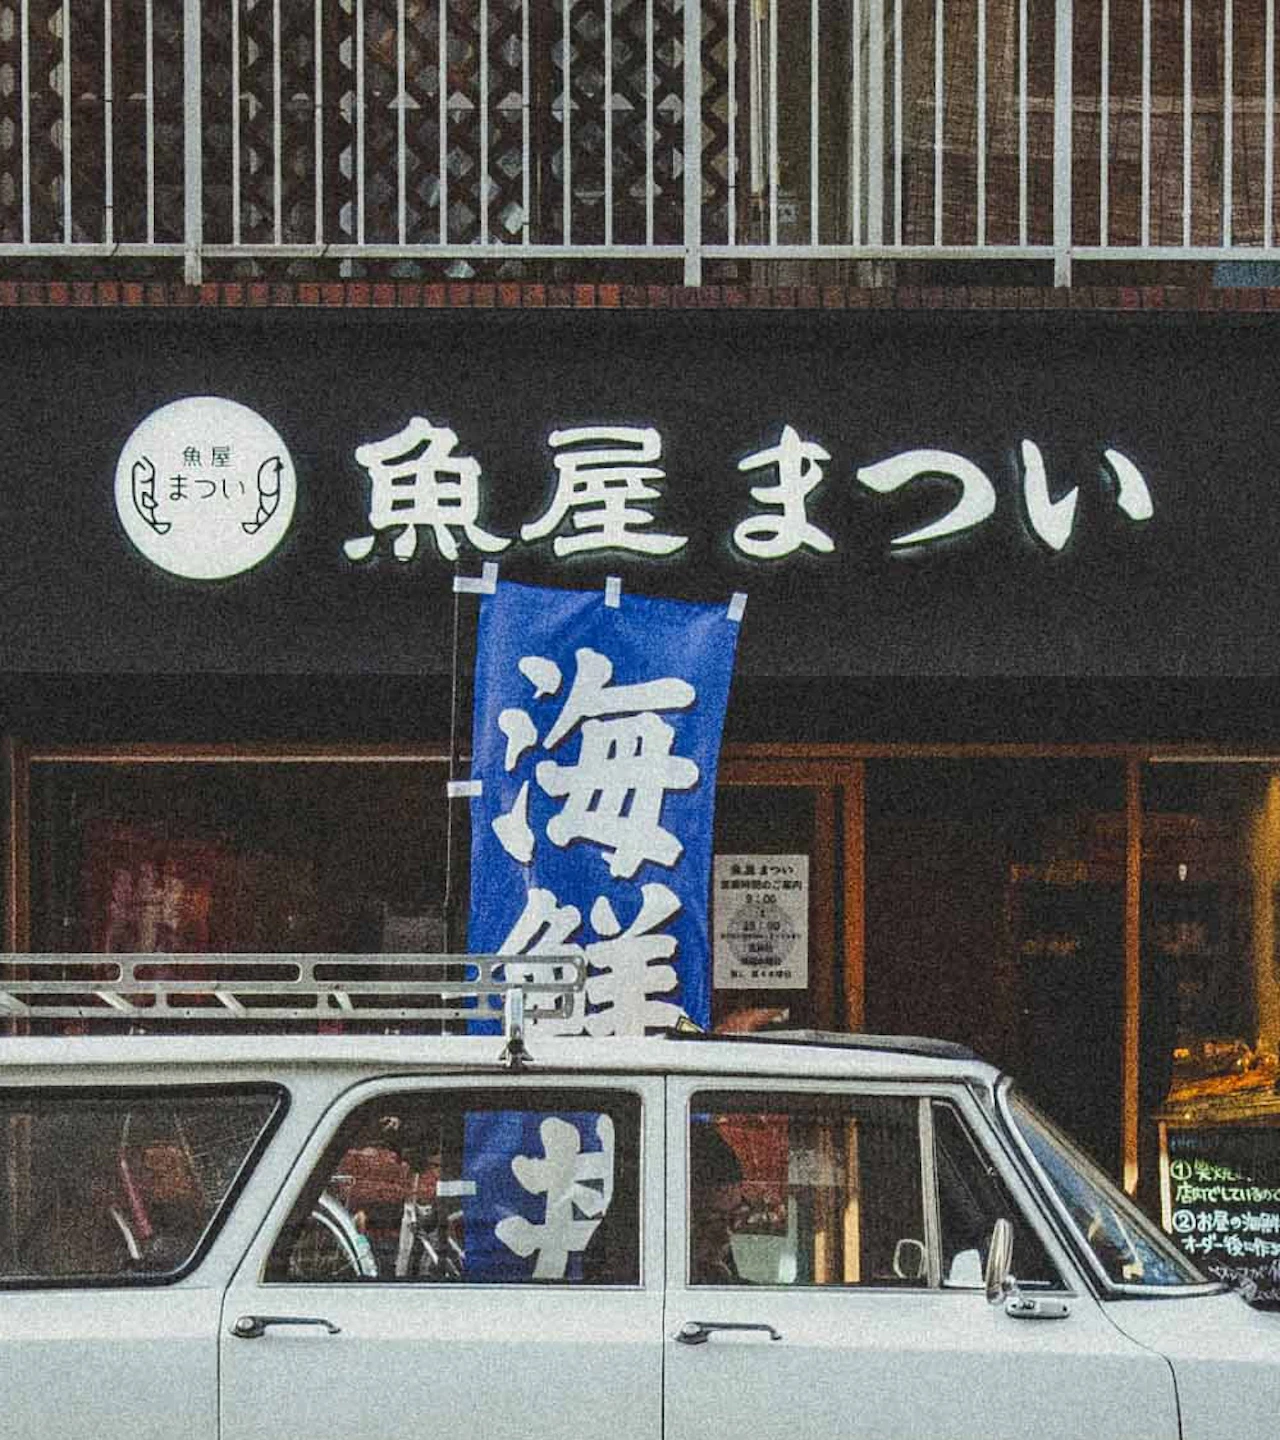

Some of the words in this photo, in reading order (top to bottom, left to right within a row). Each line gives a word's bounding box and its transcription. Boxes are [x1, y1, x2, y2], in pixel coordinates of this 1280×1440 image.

[183, 446, 232, 469] 魚屋
[169, 474, 245, 500] まつい
[344, 415, 1154, 560] 魚屋まつい
